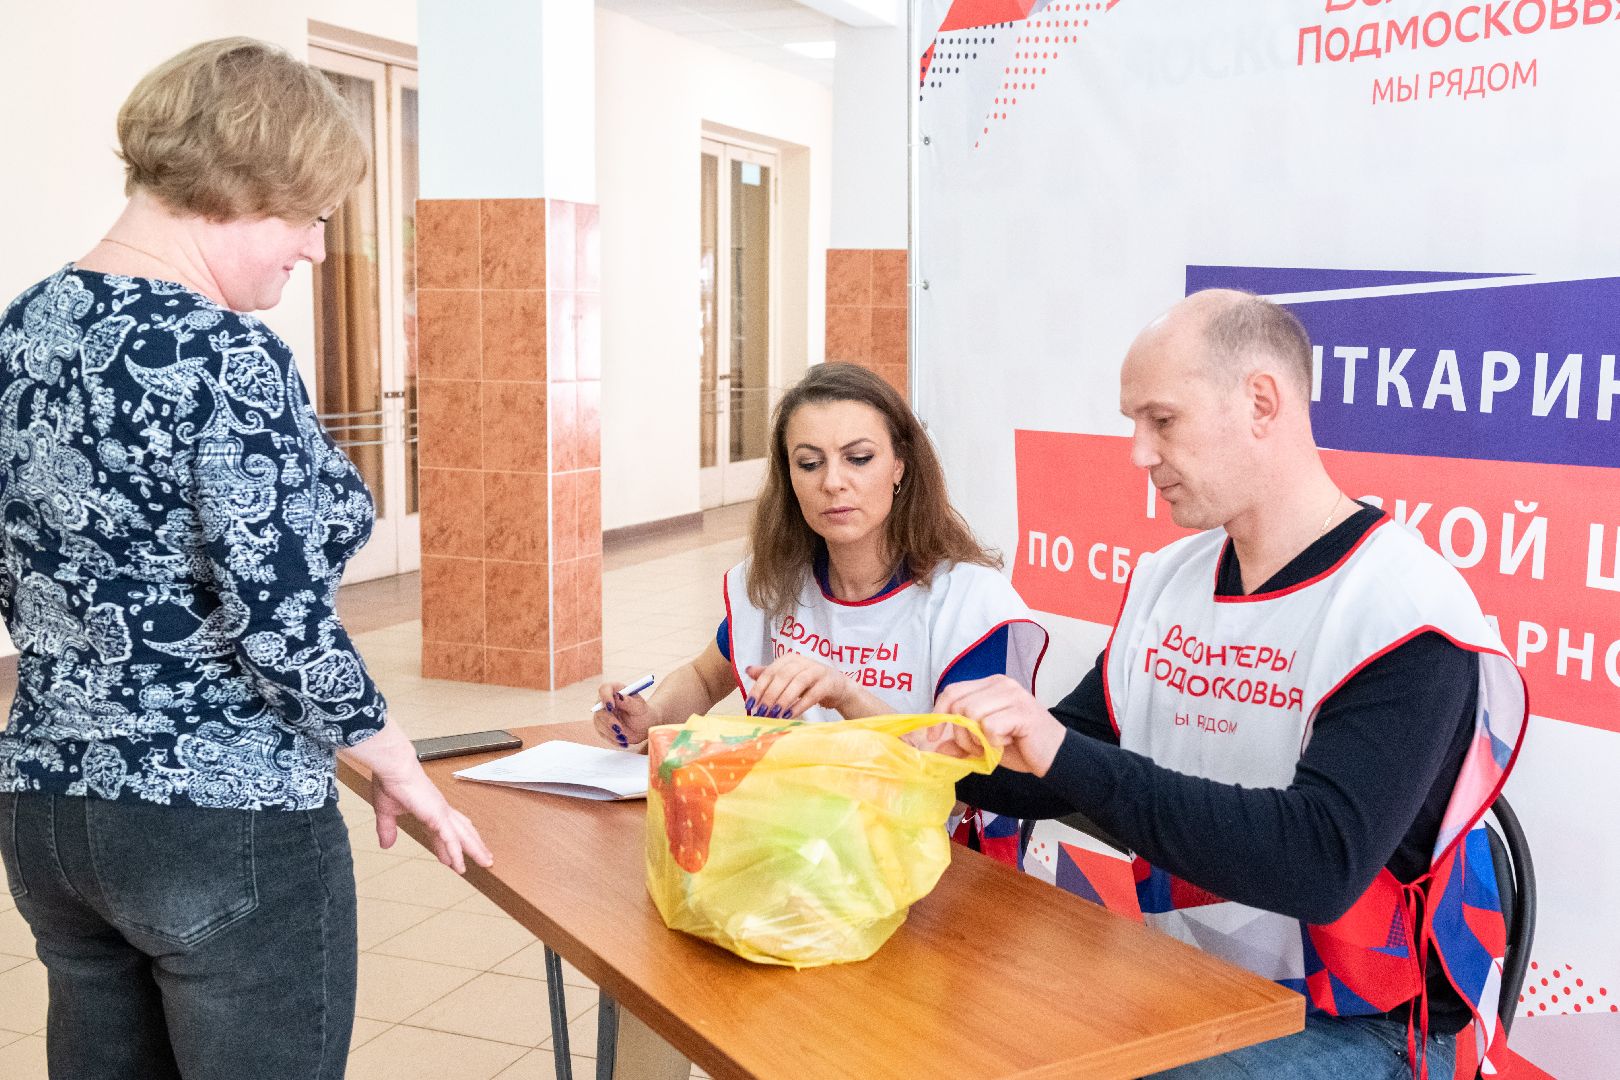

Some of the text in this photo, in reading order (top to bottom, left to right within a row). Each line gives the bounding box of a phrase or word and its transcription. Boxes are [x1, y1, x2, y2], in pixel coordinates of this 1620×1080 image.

[1297, 0, 1620, 66] ПОДМОСКОВЬ
[1372, 58, 1538, 105] МЫ РЯДОМ
[1028, 530, 1131, 584] ПО СБ
